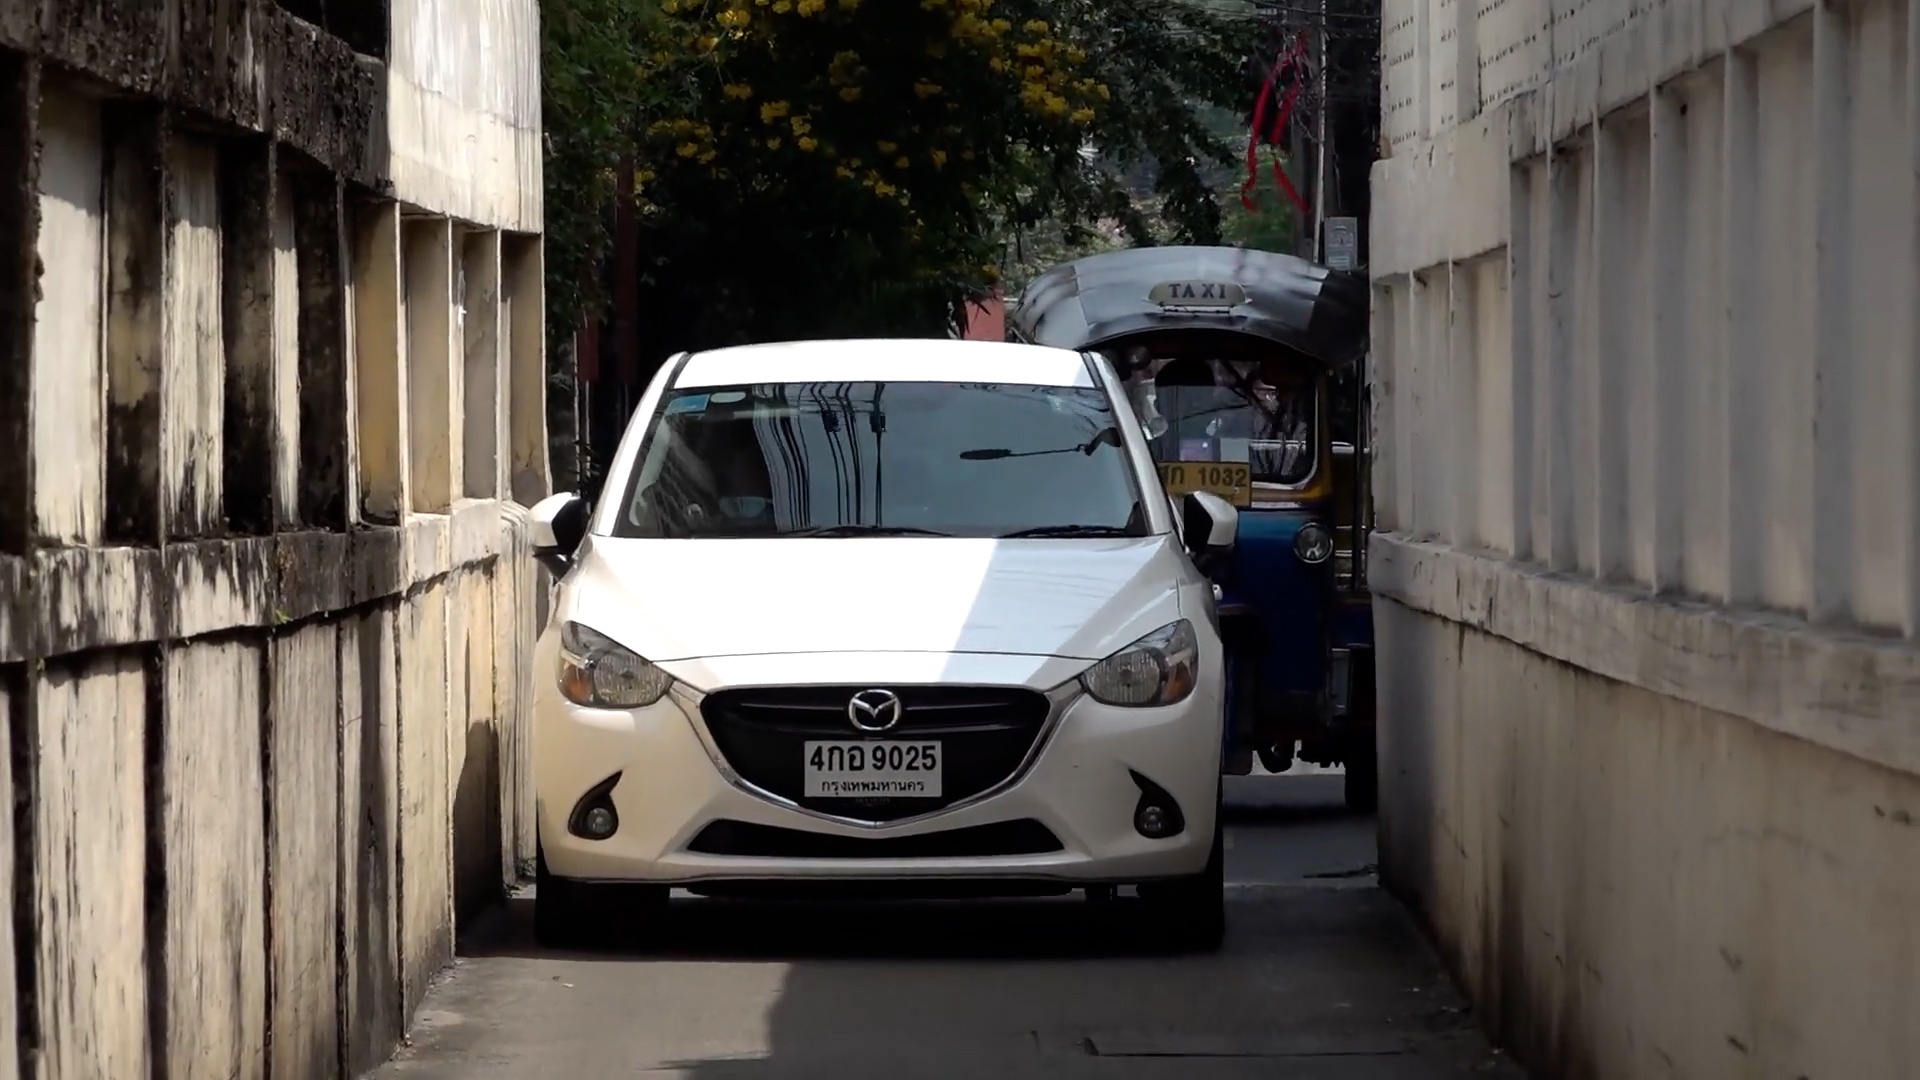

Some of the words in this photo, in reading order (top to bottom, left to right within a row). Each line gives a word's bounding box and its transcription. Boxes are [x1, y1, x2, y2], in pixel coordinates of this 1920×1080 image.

[1169, 283, 1226, 299] TAXI
[1198, 466, 1247, 488] 1032
[810, 745, 865, 771] 4กอ
[872, 745, 937, 771] 9025
[822, 780, 925, 795] กรุงเทพมหานคร
